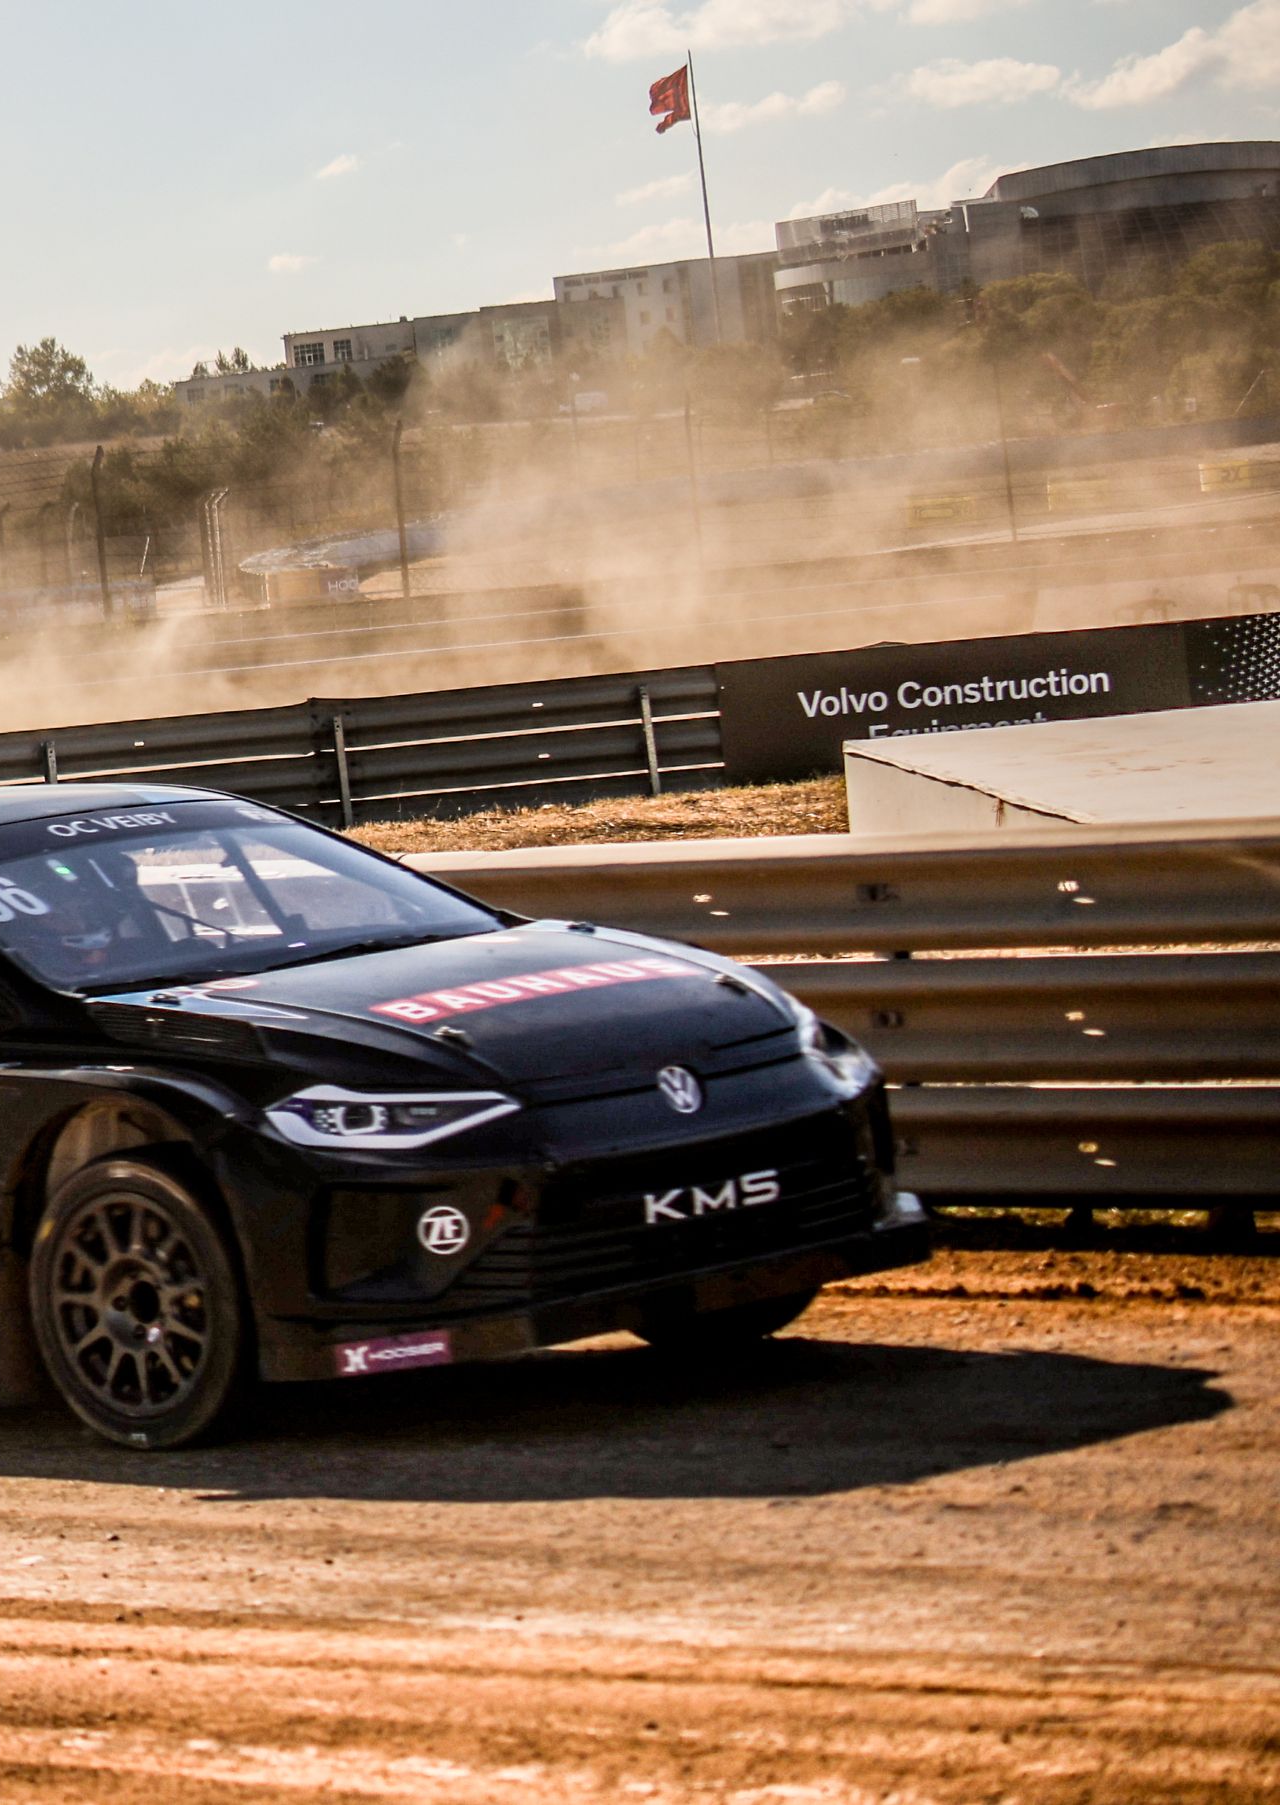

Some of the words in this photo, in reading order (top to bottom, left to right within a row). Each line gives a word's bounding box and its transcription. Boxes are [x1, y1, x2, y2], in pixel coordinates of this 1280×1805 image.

[797, 687, 887, 718] Volvo
[897, 668, 1111, 710] Construction
[47, 819, 99, 837] OC
[100, 811, 177, 831] VEIBY
[382, 958, 695, 1020] BAUHAUS
[644, 1169, 779, 1224] KMS
[419, 1211, 468, 1248] ZF
